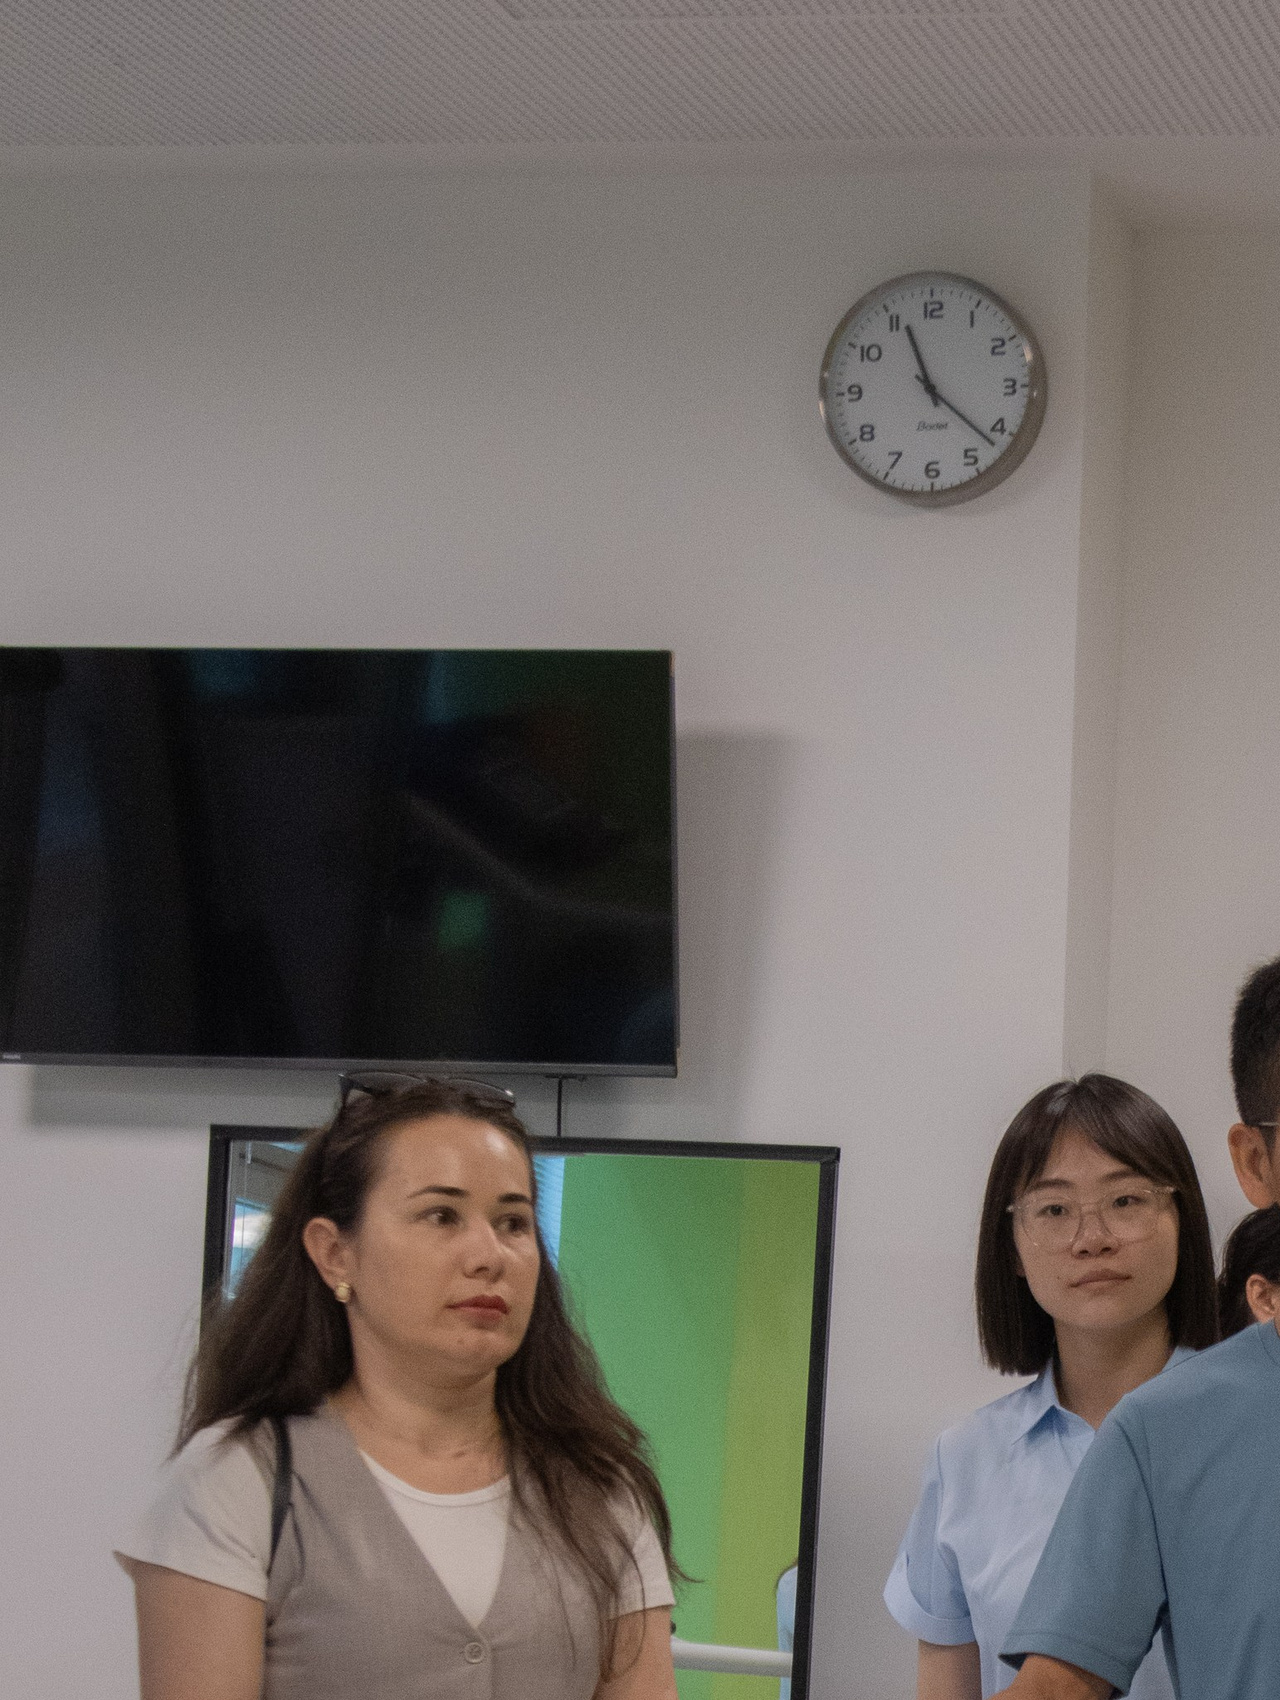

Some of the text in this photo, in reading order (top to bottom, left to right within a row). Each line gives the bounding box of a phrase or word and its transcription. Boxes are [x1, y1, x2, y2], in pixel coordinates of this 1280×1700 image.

[924, 301, 943, 318] 12
[890, 315, 899, 331] 11
[969, 310, 976, 328] 1
[860, 344, 882, 362] 10
[991, 338, 1006, 355] 2
[848, 385, 862, 401] 9
[1004, 378, 1017, 395] 3
[860, 425, 874, 441] 8
[990, 418, 1006, 435] 4
[889, 451, 902, 469] 7
[964, 449, 978, 466] 5
[925, 462, 940, 479] 6
